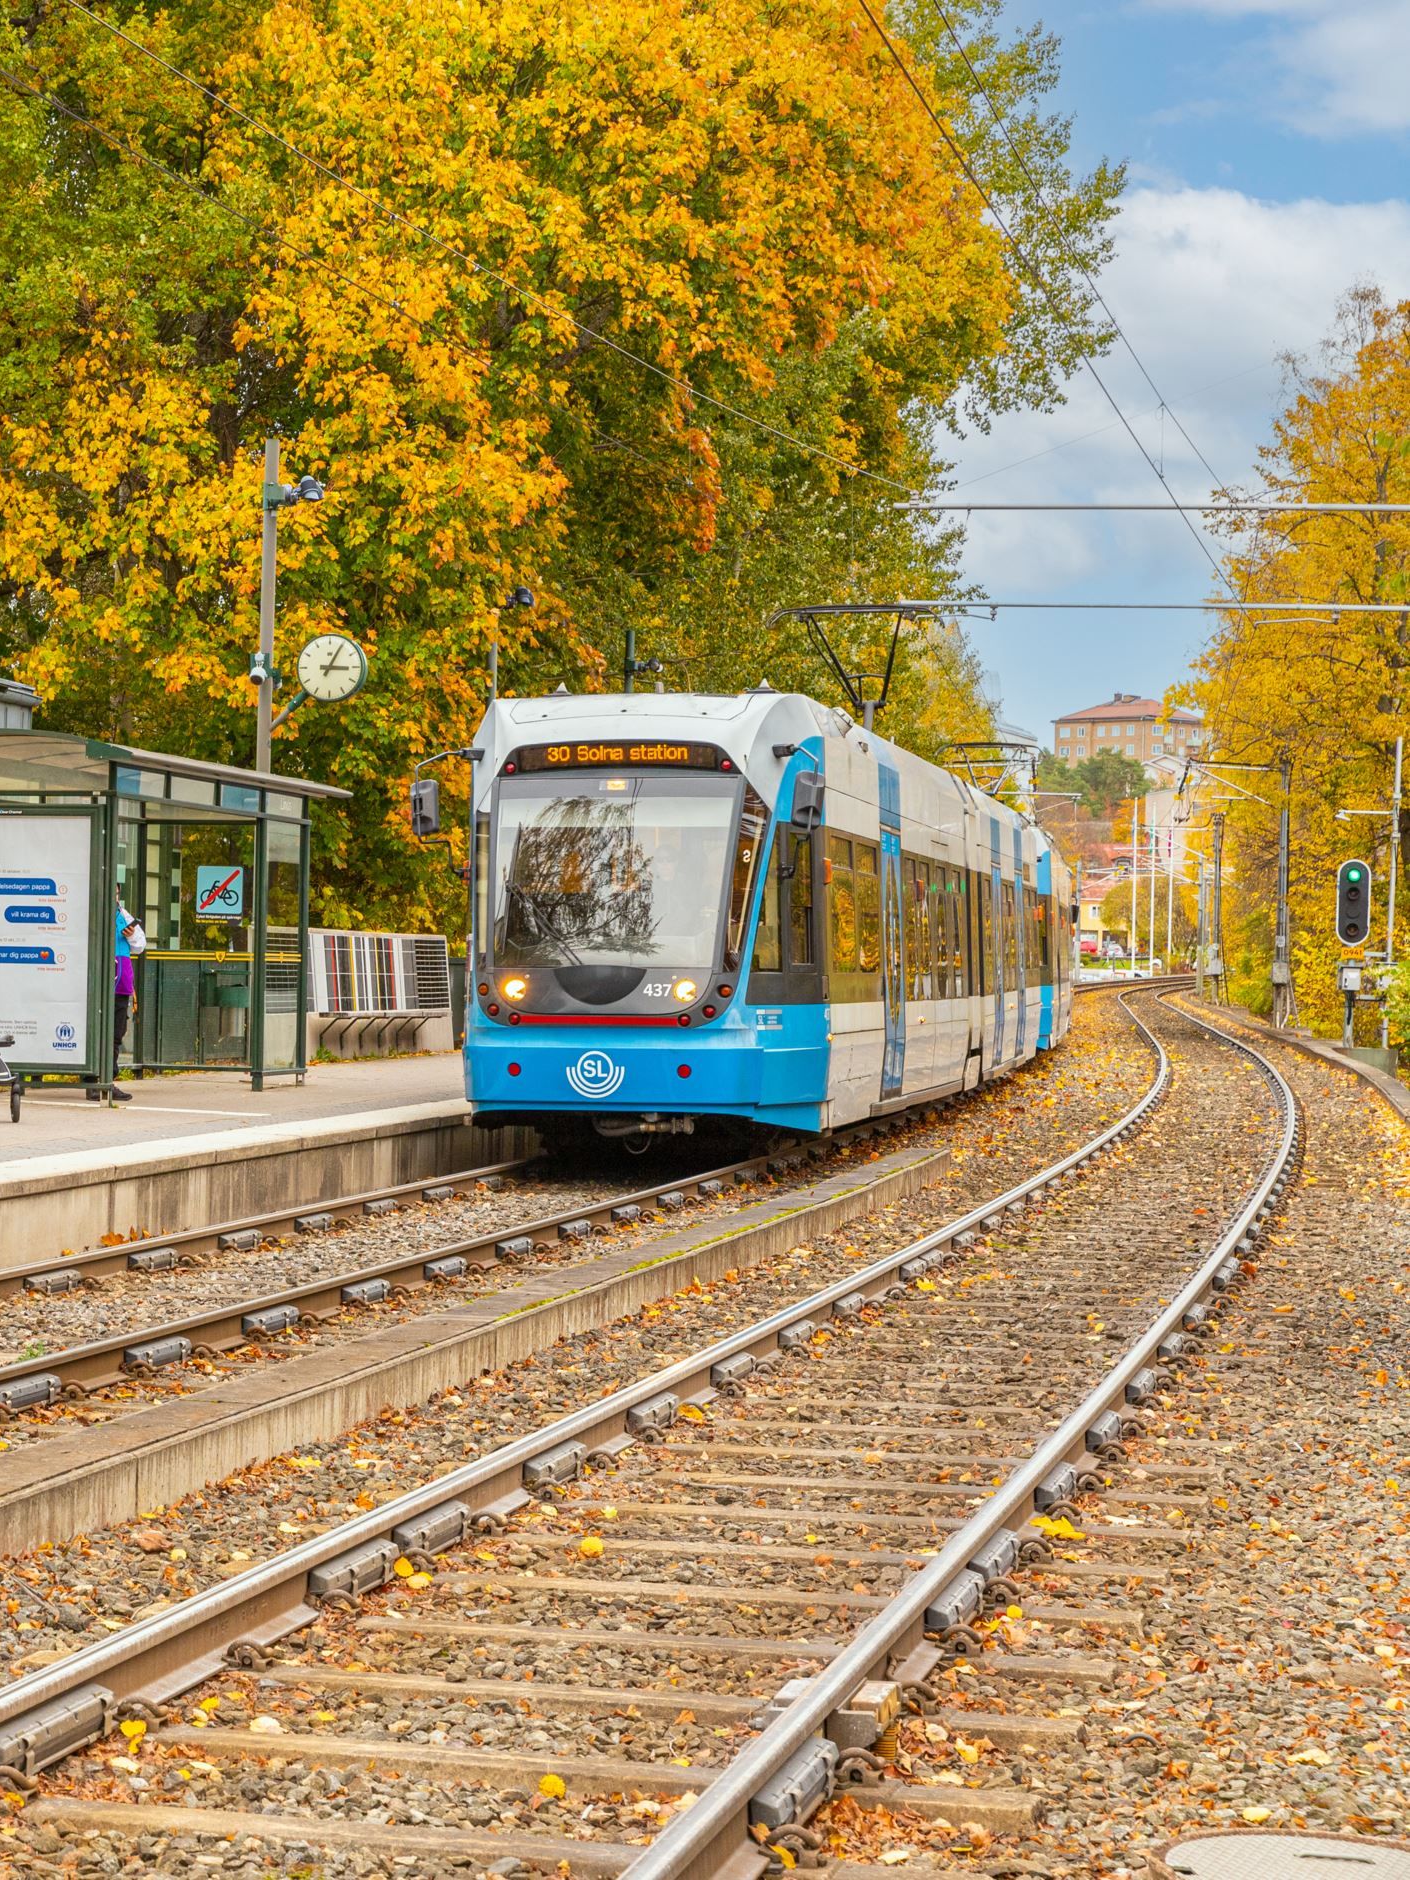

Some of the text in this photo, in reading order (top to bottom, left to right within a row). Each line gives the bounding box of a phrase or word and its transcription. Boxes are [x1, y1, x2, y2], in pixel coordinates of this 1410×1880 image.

[547, 743, 688, 762] 30 Solna station
[39, 911, 50, 919] dig
[643, 983, 672, 997] 437
[583, 1059, 608, 1078] SL
